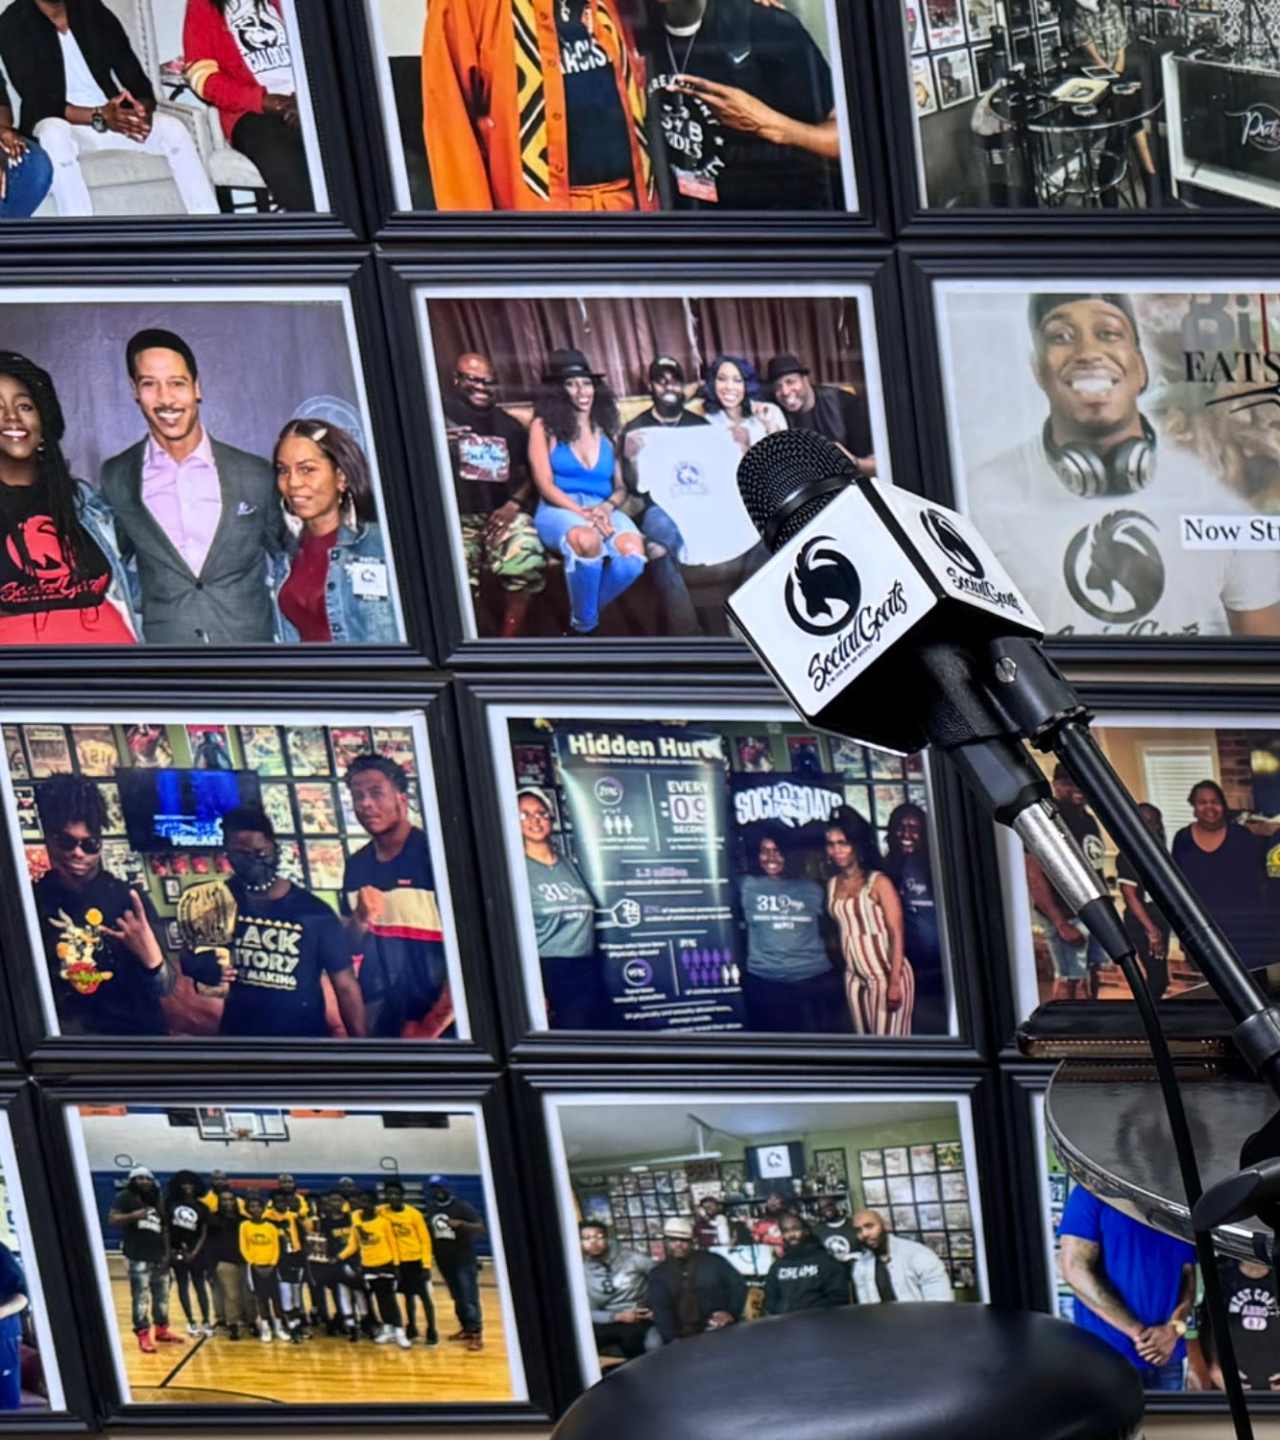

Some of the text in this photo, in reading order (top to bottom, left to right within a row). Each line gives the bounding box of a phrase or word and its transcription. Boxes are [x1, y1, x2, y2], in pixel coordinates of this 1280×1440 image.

[1183, 518, 1241, 542] Now
[567, 732, 656, 757] Hidden
[757, 895, 777, 912] 31
[1228, 1287, 1252, 1313] WEST
